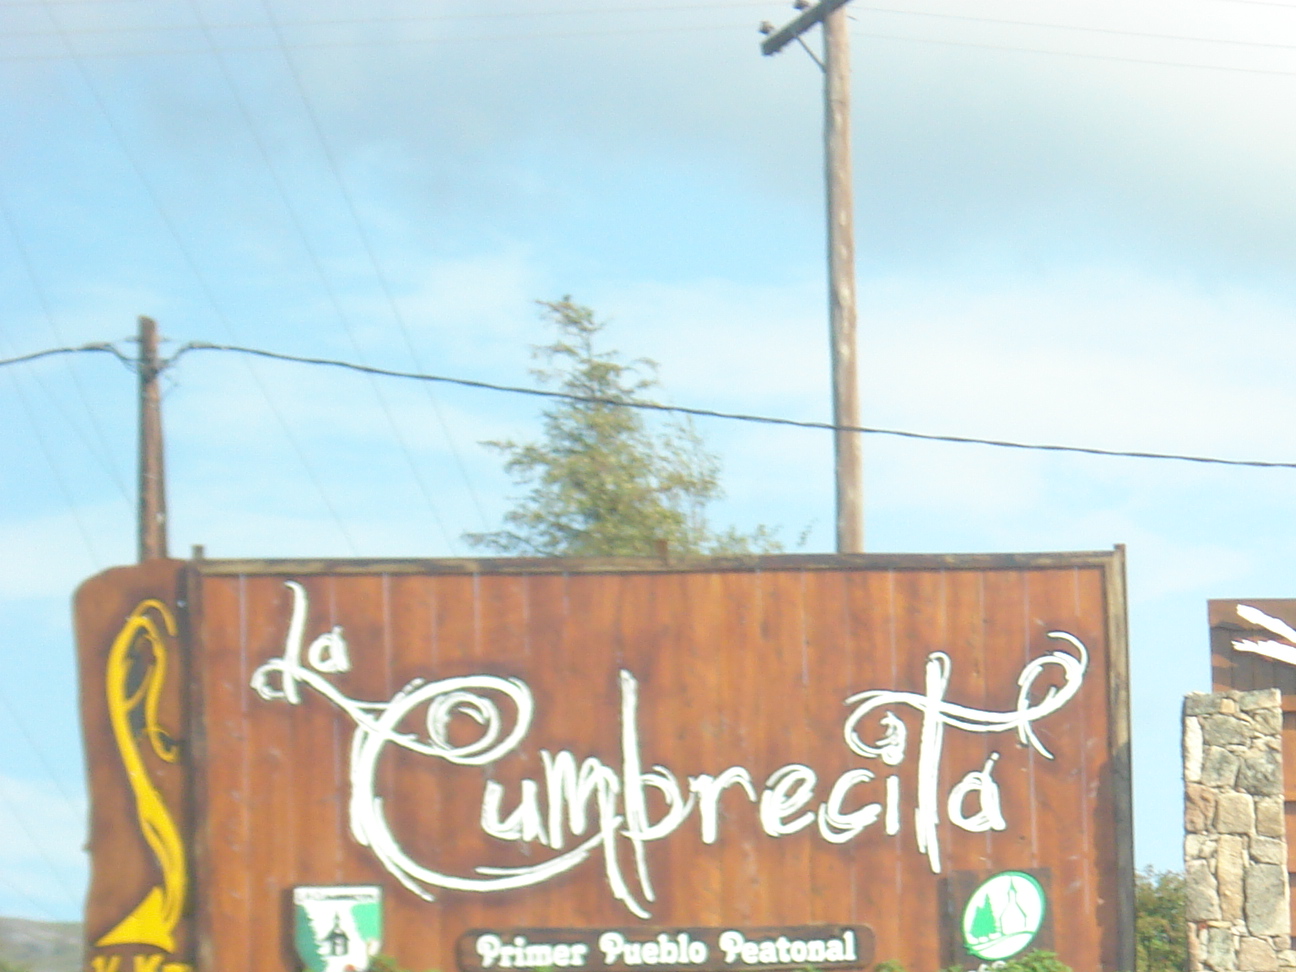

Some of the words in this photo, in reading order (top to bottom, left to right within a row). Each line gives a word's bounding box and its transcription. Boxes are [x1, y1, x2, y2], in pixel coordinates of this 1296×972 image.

[250, 580, 351, 705] La
[348, 630, 1088, 920] Cumbrecita
[476, 933, 588, 968] Primer
[599, 931, 708, 965] Pueblo
[718, 929, 857, 964] Peatonal
